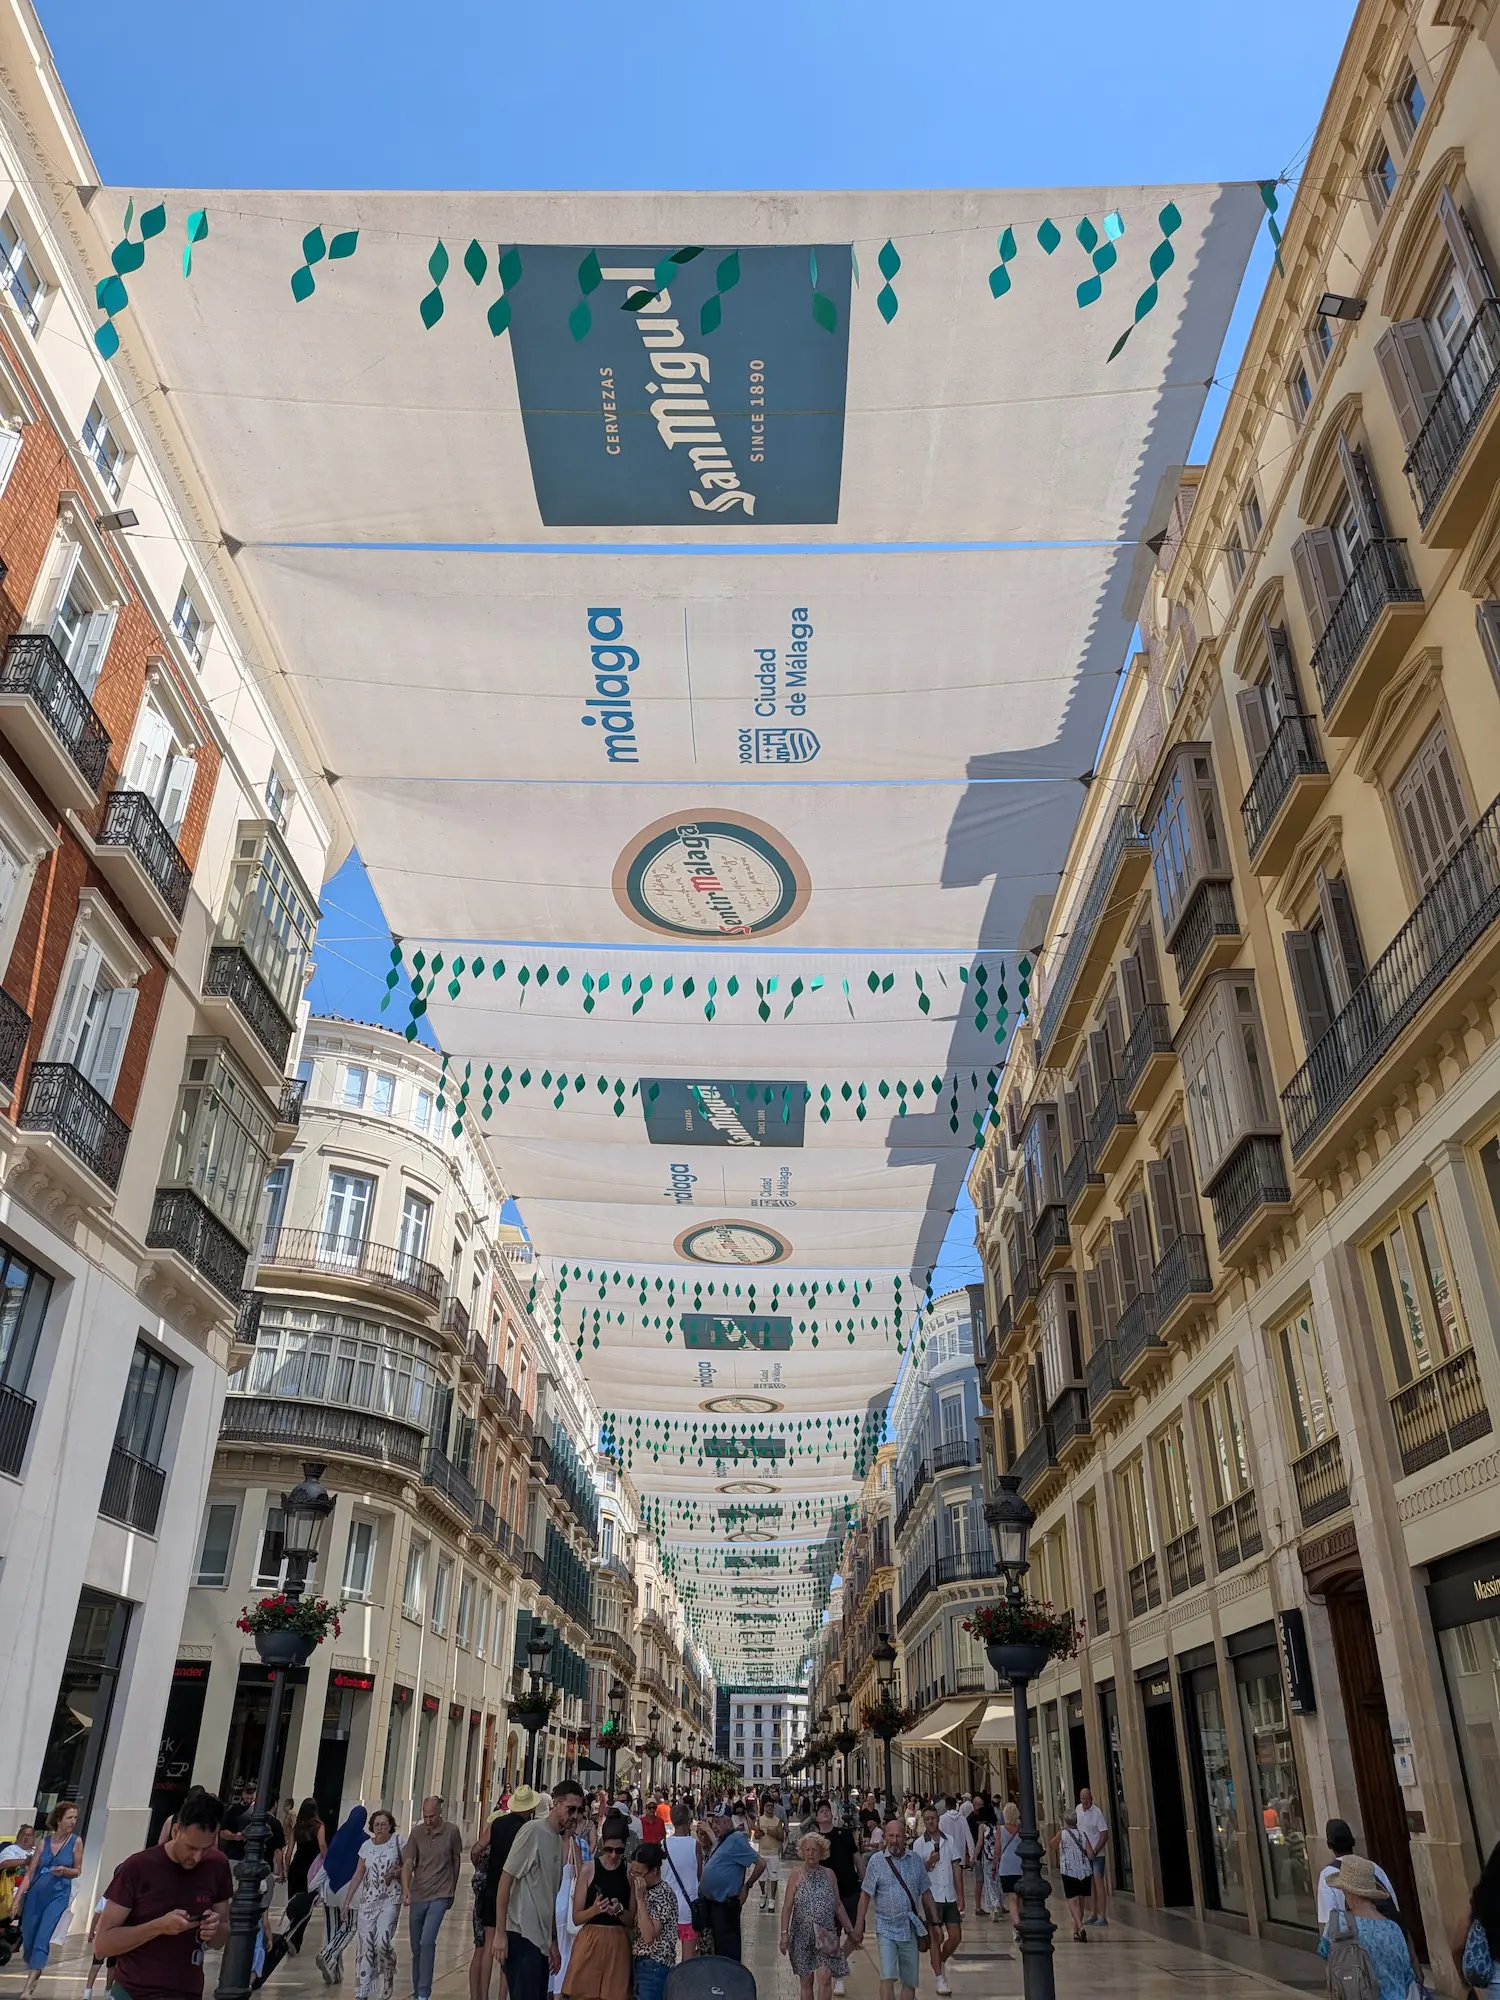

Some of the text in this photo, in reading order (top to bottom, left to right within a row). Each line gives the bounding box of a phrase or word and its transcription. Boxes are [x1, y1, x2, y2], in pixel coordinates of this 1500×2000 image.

[600, 267, 756, 516] San Miguel
[600, 367, 621, 455] CERVEZAS
[749, 359, 765, 462] SINCE 1890
[581, 607, 640, 763] málaga
[754, 648, 776, 717] Ciudad
[785, 607, 814, 716] de Málaga
[759, 1177, 772, 1198] Ciudad
[776, 1166, 793, 1190] Málaga
